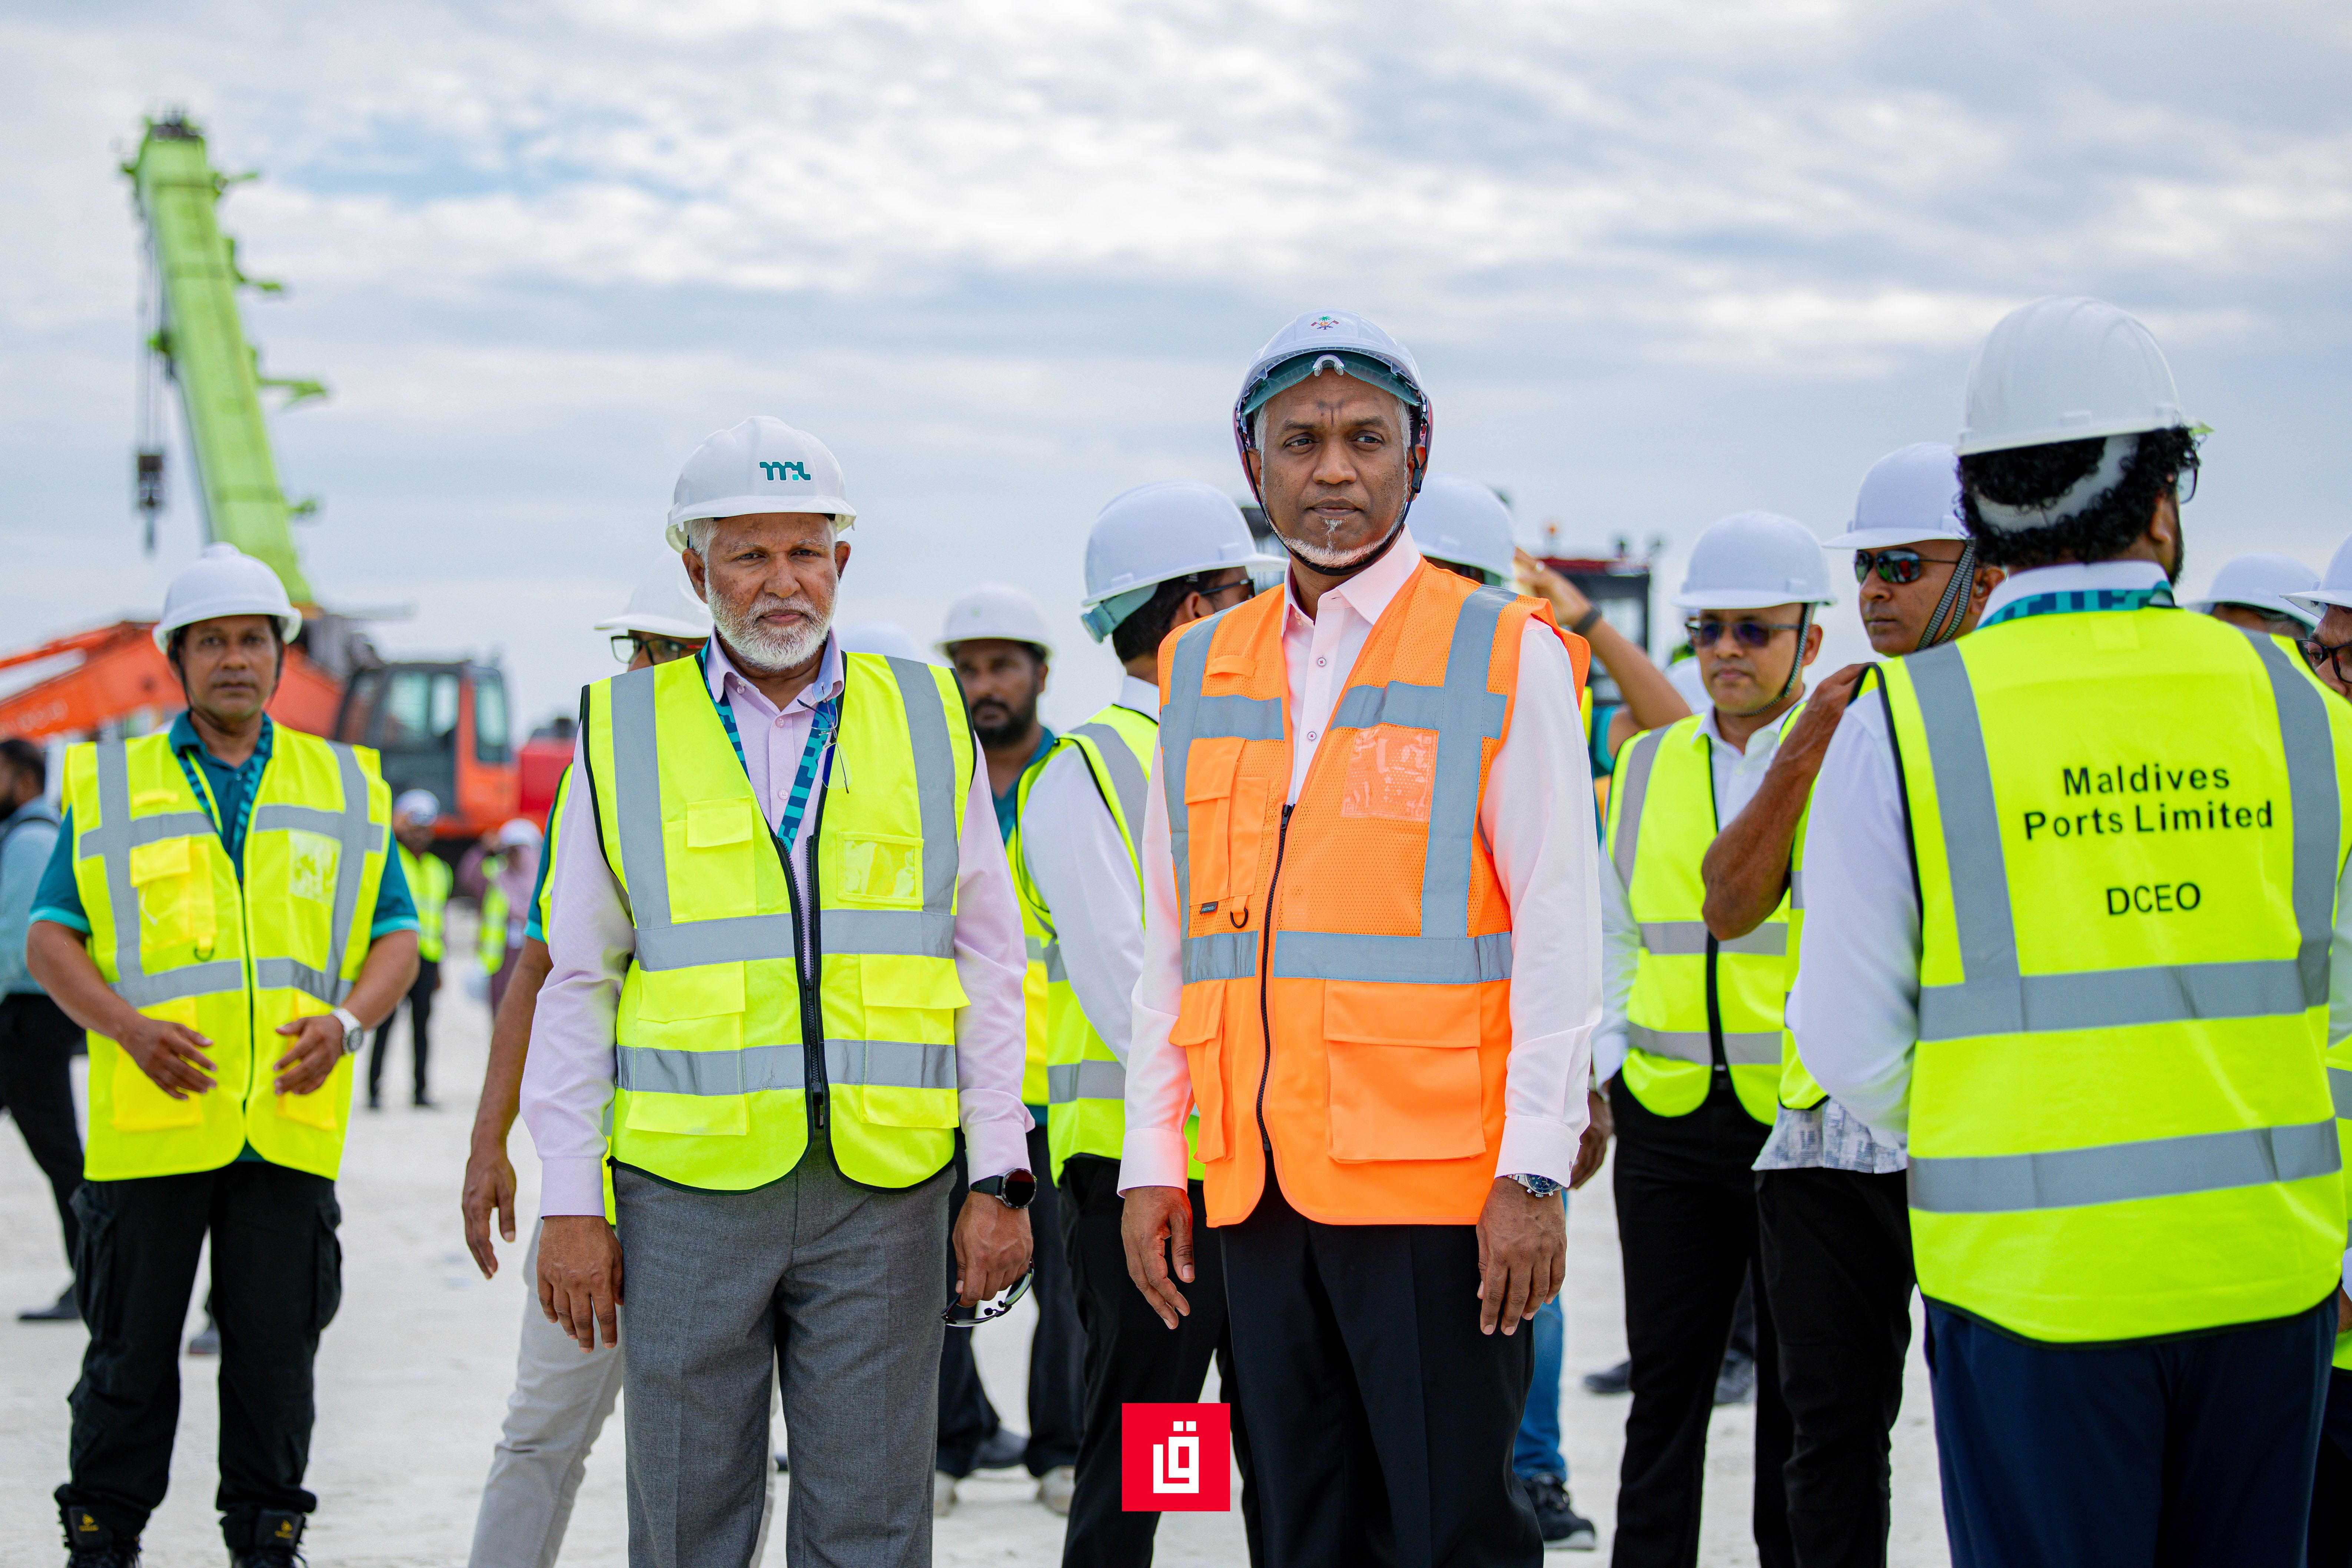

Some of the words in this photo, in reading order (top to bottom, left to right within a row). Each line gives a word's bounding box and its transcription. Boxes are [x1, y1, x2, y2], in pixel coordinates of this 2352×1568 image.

[2063, 764, 2230, 795] Maldives
[2024, 807, 2123, 840] Ports
[2135, 801, 2273, 832] Limited
[2106, 883, 2200, 916] DCEO
